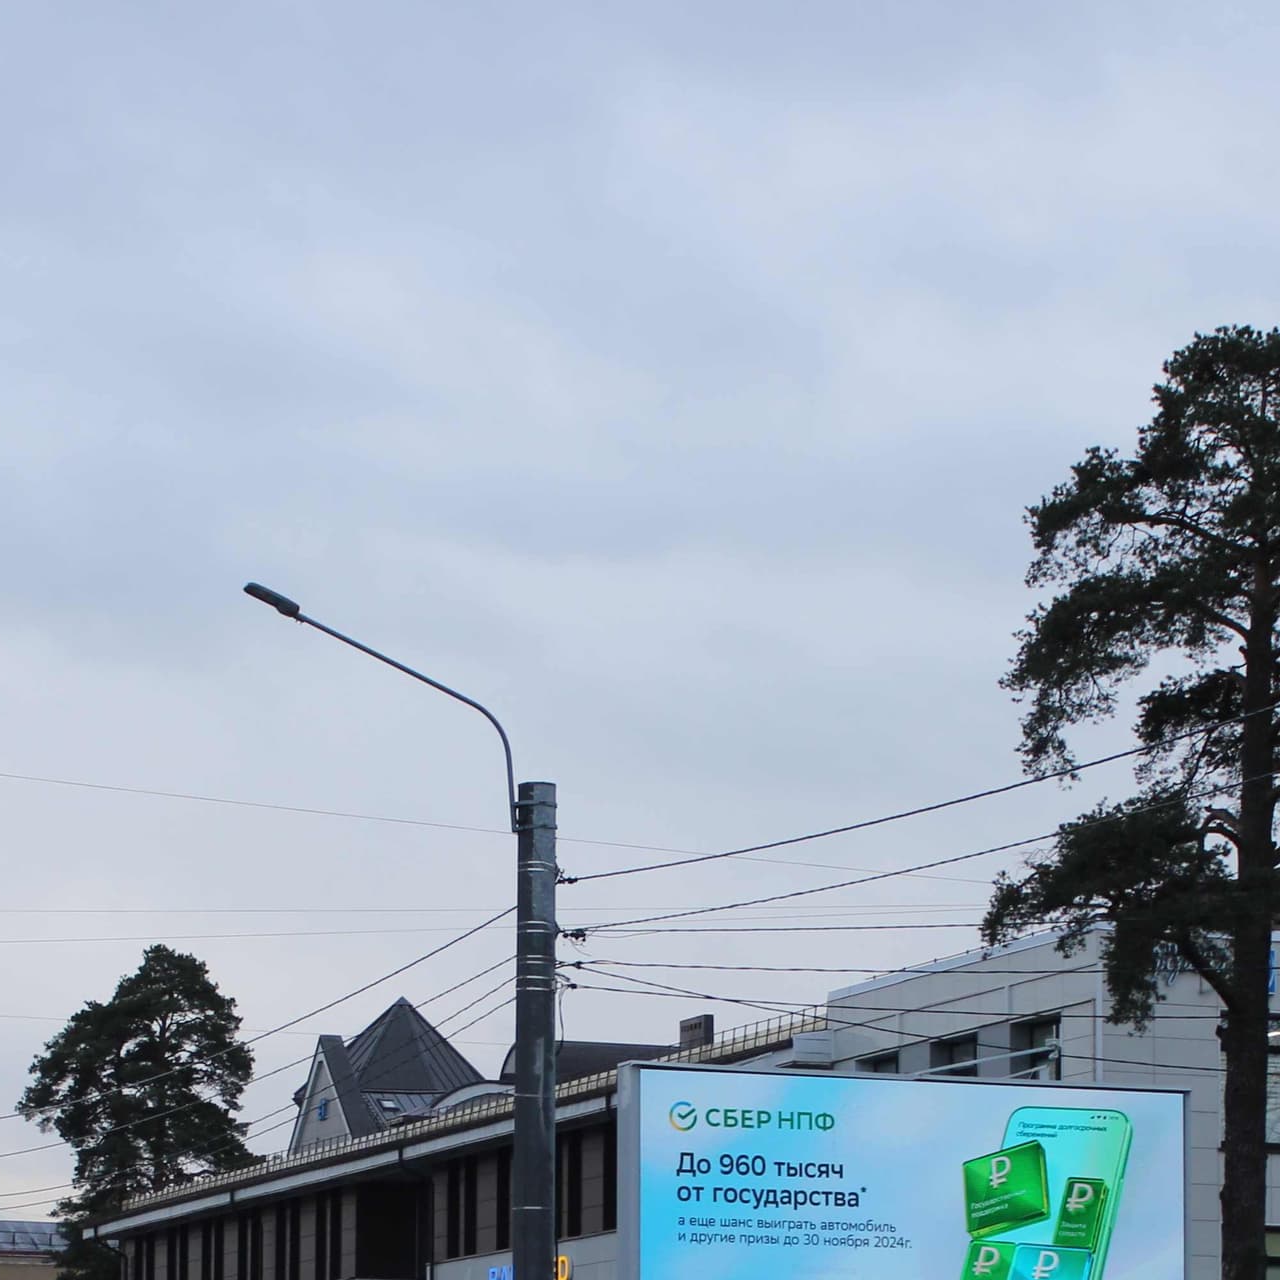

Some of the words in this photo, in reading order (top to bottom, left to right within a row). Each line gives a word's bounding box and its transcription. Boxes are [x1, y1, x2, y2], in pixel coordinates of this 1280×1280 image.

[705, 1108, 771, 1129] СБЕР
[778, 1111, 835, 1131] НПФ
[676, 1152, 711, 1177] До
[720, 1154, 766, 1176] 960
[773, 1161, 844, 1179] тысяч
[677, 1186, 704, 1202] от
[678, 1217, 685, 1226] а
[689, 1217, 716, 1228] еще
[720, 1218, 753, 1228] шанс
[757, 1219, 817, 1232] выиграть
[820, 1219, 897, 1233] автомобиль
[678, 1233, 686, 1242] и
[690, 1233, 735, 1247] другие
[739, 1233, 780, 1247] призы
[783, 1235, 799, 1246] до
[803, 1234, 820, 1246] 30
[823, 1234, 870, 1249] ноября
[874, 1236, 912, 1249] 2024г.
